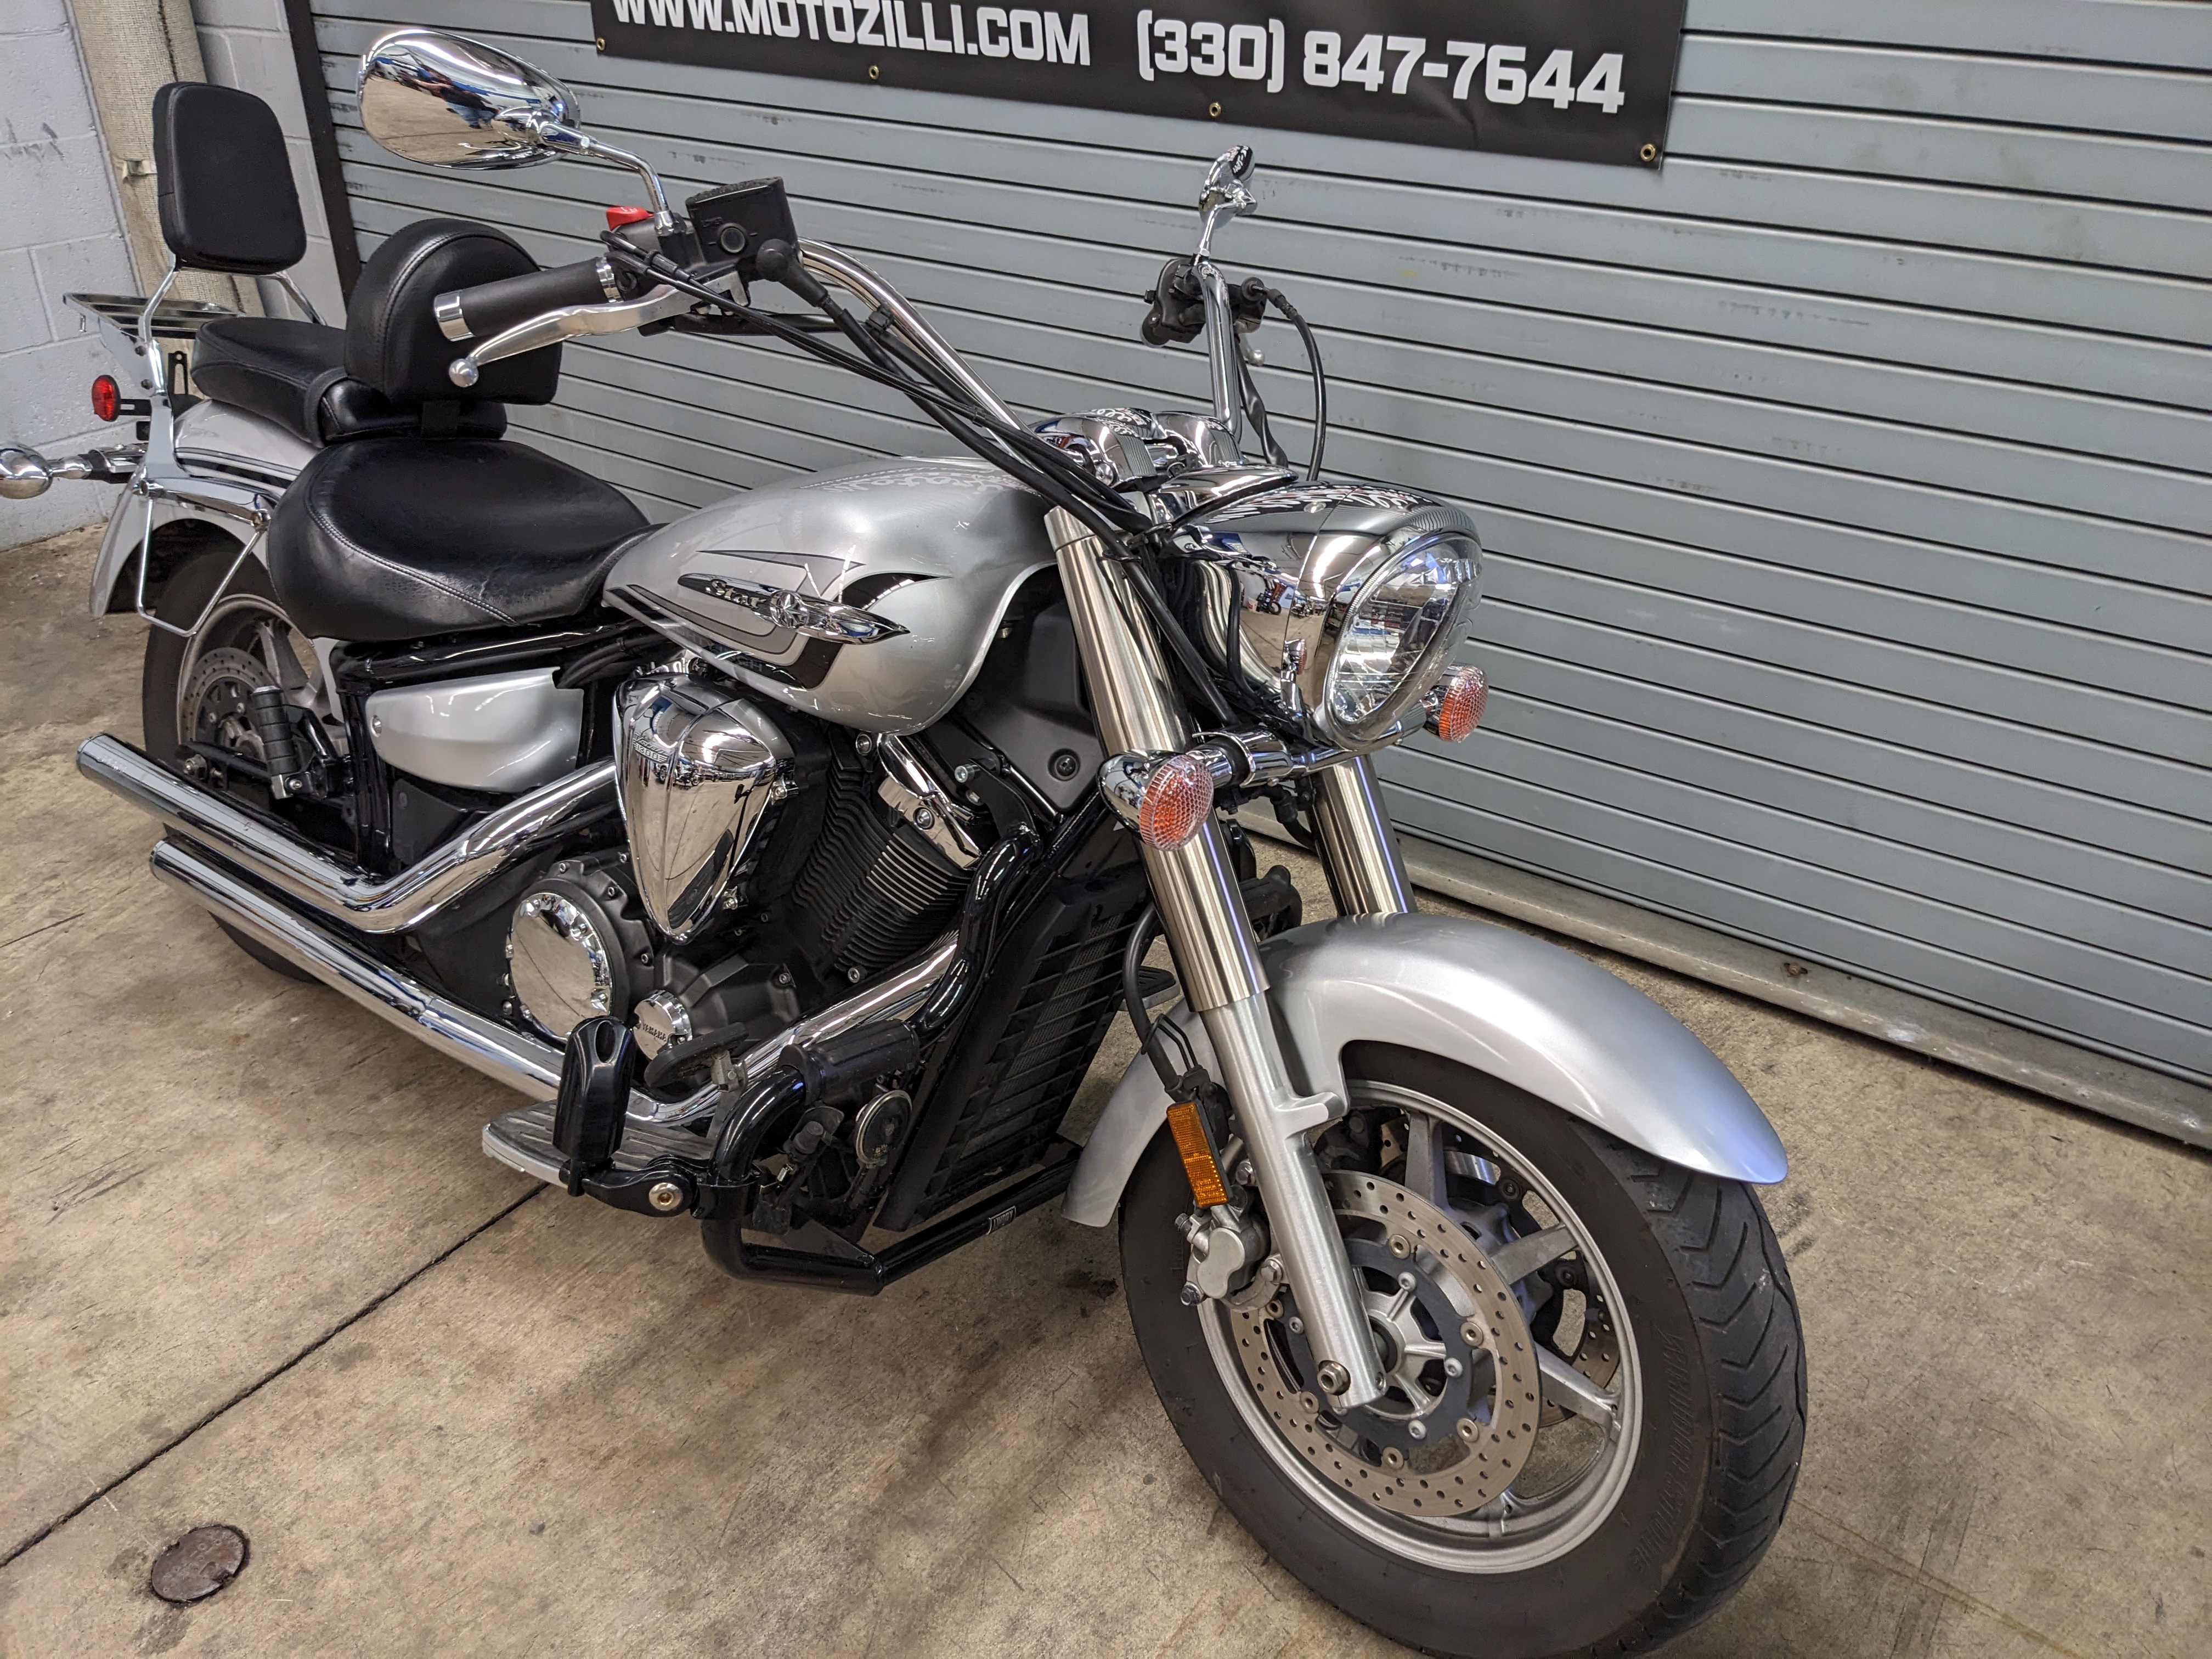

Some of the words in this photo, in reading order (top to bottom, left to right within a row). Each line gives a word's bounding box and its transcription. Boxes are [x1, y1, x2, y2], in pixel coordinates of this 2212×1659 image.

[613, 0, 1091, 66] WWW.MOTOZILLI.COM
[1137, 10, 1285, 93] (330)
[1303, 31, 1625, 114] 847-7644
[642, 1023, 667, 1042] YAMAHA
